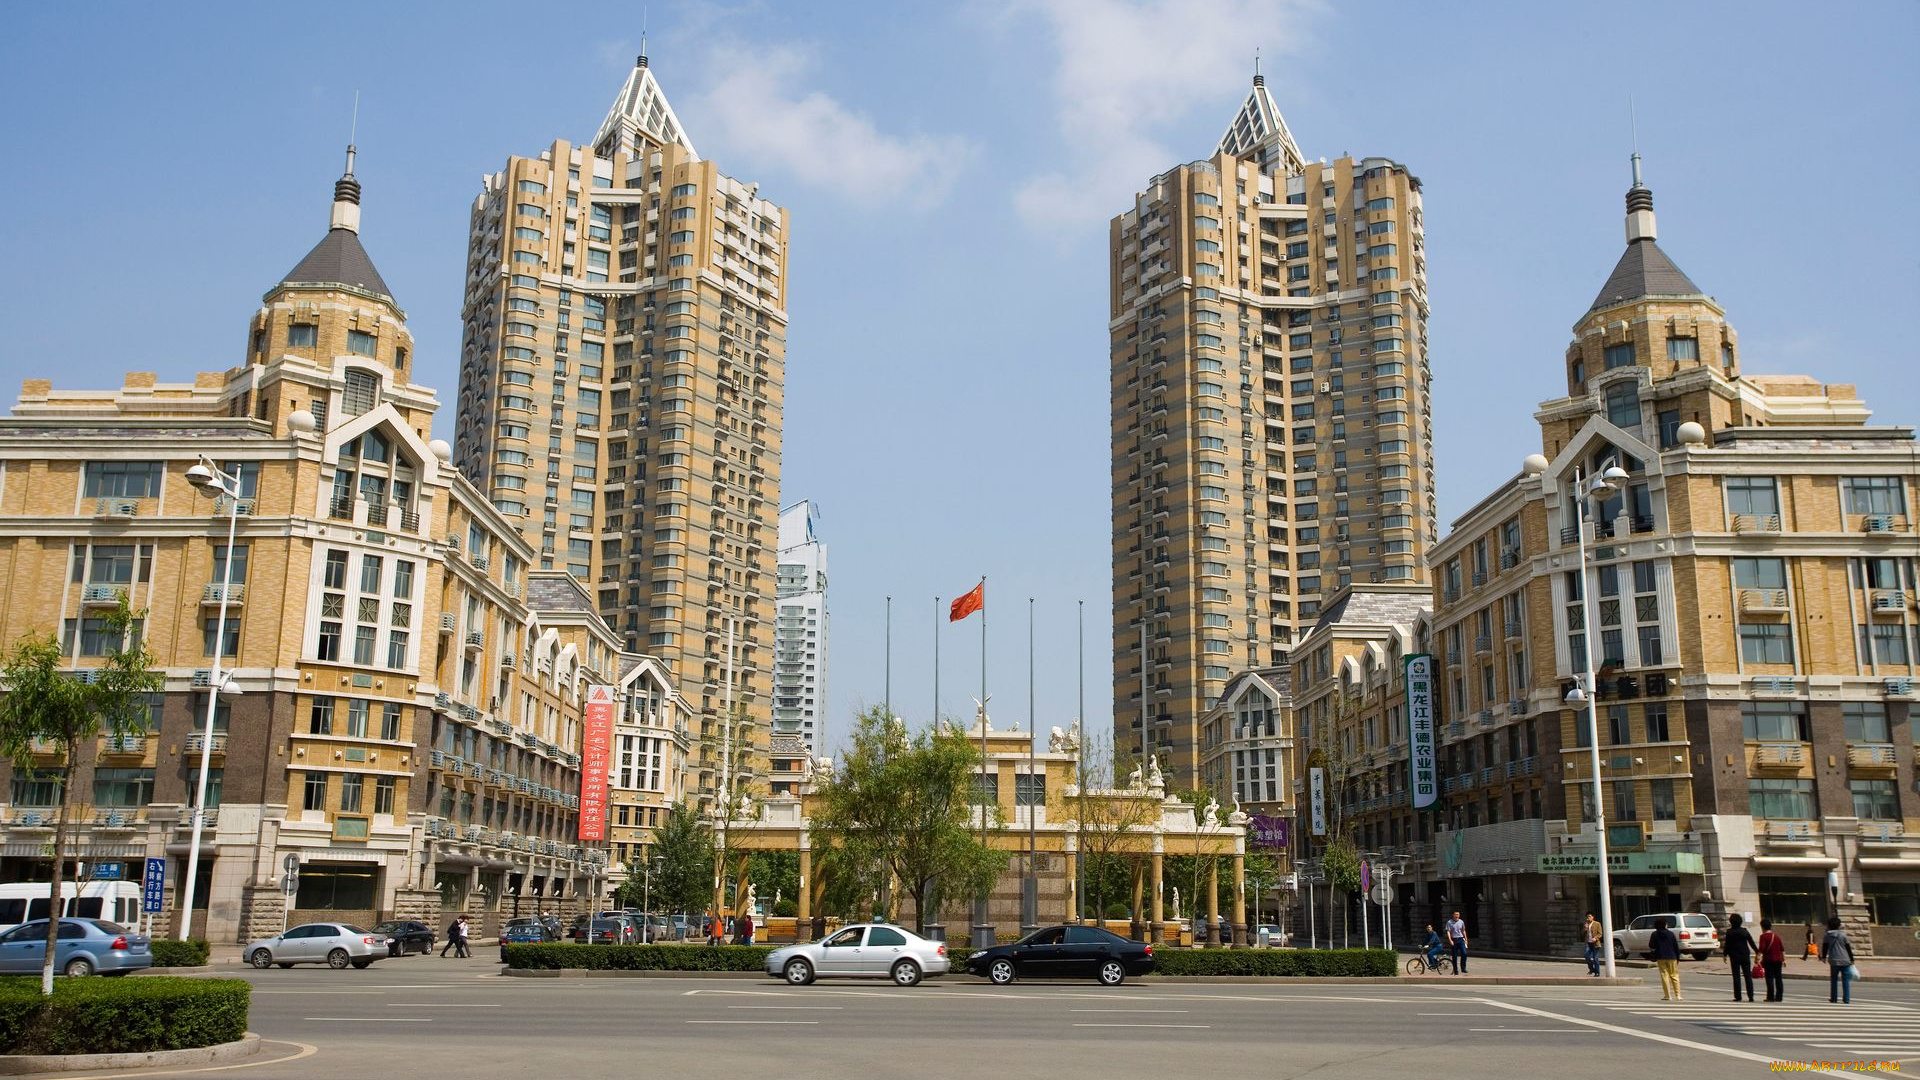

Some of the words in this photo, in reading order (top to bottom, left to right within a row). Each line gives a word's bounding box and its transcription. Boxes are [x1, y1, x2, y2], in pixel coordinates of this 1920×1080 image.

[1413, 682, 1433, 794] 黑龙江丰德农业集团
